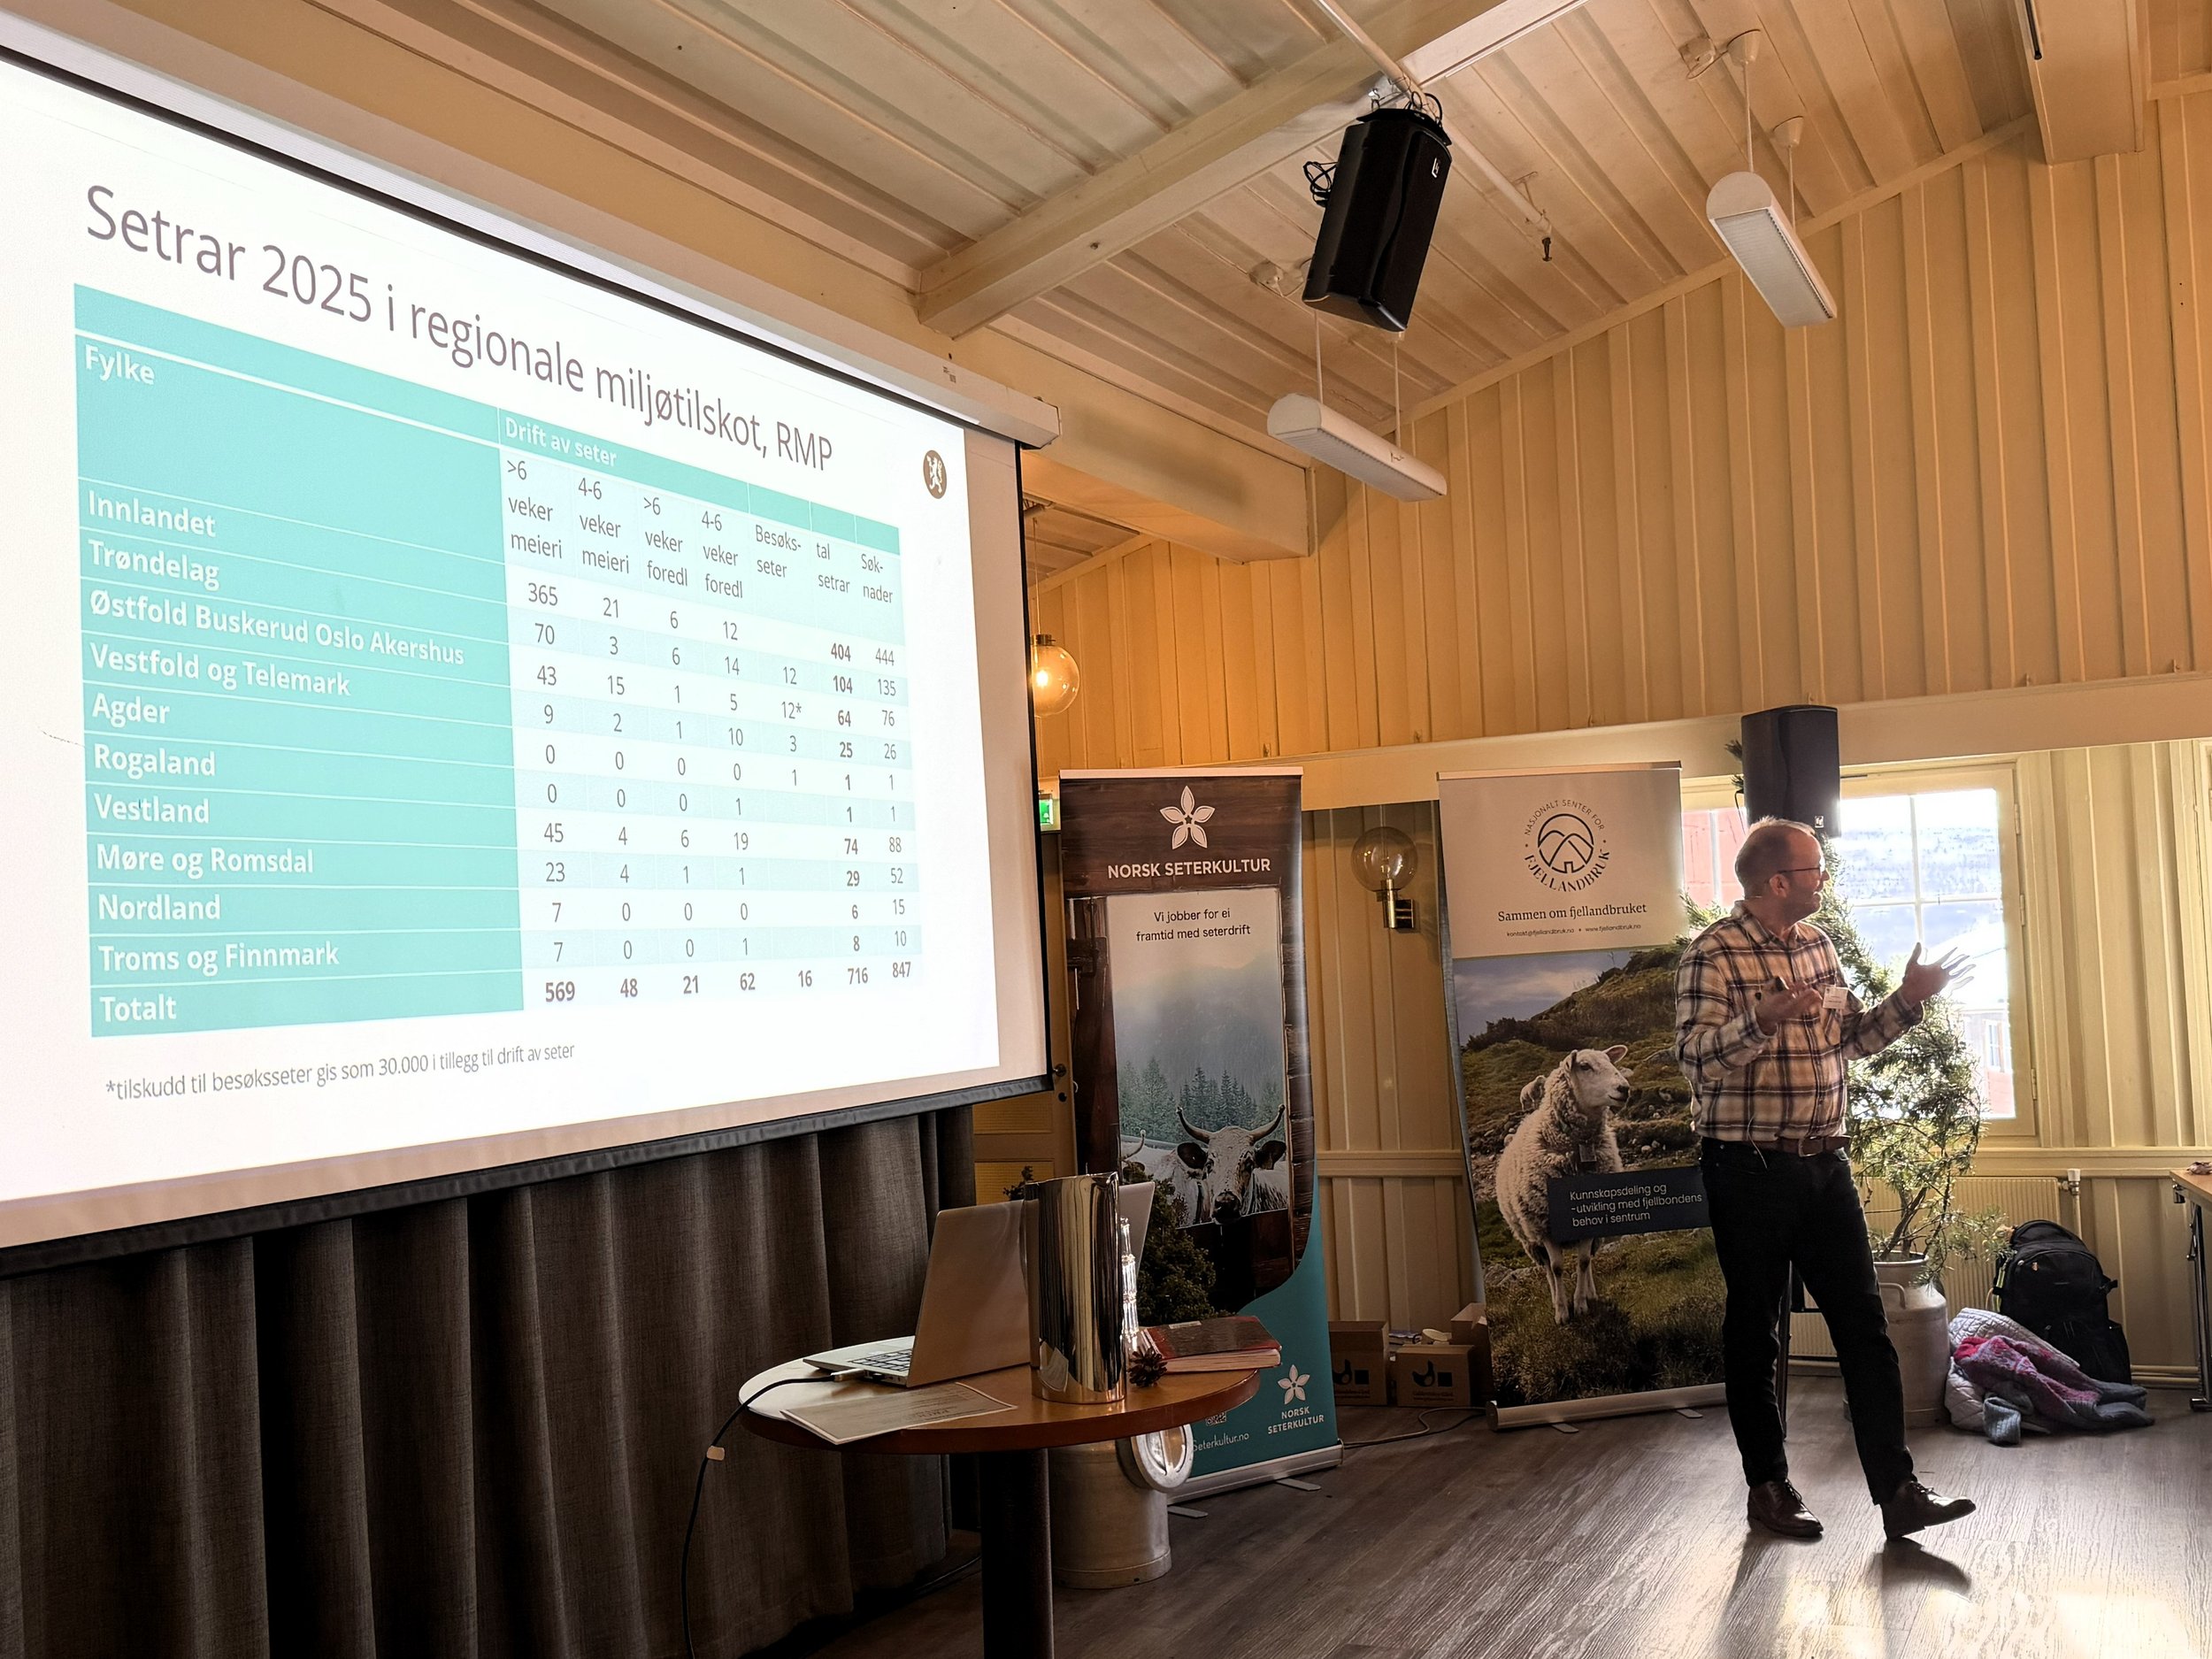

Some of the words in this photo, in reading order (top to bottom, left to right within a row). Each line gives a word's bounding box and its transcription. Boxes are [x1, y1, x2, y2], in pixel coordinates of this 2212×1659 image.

[87, 185, 246, 281] Setrar
[262, 244, 372, 323] 2025
[387, 283, 395, 332] i
[411, 303, 583, 393] regionale
[597, 365, 767, 459] miljøtilskot,
[776, 421, 833, 472] RMP
[85, 345, 156, 385] Fylke
[506, 417, 547, 448] Drift
[550, 435, 571, 455] av
[574, 441, 618, 468] seter
[506, 460, 527, 480] >6
[578, 477, 603, 501] 4-6
[88, 490, 216, 538] Innlandet
[508, 496, 554, 522] veker
[643, 496, 661, 516] >6
[579, 514, 621, 539] veker
[701, 511, 723, 532] 4-6
[511, 534, 563, 559] meieri
[644, 530, 683, 553] veker
[755, 524, 802, 551] Besøks-
[816, 542, 831, 560] tal
[88, 538, 220, 591] Trøndelag
[582, 549, 629, 574] meieri
[703, 544, 739, 566] veker
[757, 559, 787, 578] seter
[861, 553, 884, 573] Søk-
[647, 559, 688, 587] foredl
[704, 572, 743, 599] foredl
[818, 574, 850, 594] setrar
[863, 585, 894, 603] nader
[90, 588, 189, 627] Østfold
[195, 605, 310, 644] Buskerud
[315, 623, 365, 650] Oslo
[369, 630, 465, 666] Akershus
[527, 582, 558, 607] 365
[603, 596, 618, 618] 21
[670, 611, 679, 629] 6
[723, 620, 738, 641] 12
[830, 642, 851, 662] 404
[875, 648, 895, 666] 444
[90, 641, 200, 680] Vestfold
[208, 662, 236, 691] og
[242, 661, 351, 698] Telemark
[534, 622, 555, 645] 70
[609, 635, 618, 656] 3
[672, 647, 680, 665] 6
[725, 656, 740, 676] 14
[783, 666, 797, 686] 12
[833, 675, 853, 695] 104
[877, 678, 896, 696] 135
[536, 664, 557, 687] 43
[607, 675, 626, 695] 15
[674, 685, 680, 703] 1
[730, 693, 738, 711] 5
[837, 709, 851, 727] 64
[881, 709, 895, 727] 76
[91, 693, 170, 728] Agder
[543, 703, 554, 725] 9
[612, 712, 623, 733] 2
[676, 720, 682, 740] 1
[728, 727, 744, 747] 10
[789, 734, 797, 753] 3
[839, 741, 853, 758] 25
[884, 742, 897, 760] 26
[94, 744, 217, 780] Rogaland
[545, 744, 556, 764] 0
[615, 751, 625, 771] 0
[677, 757, 686, 776] 0
[733, 763, 741, 781] 0
[792, 769, 797, 787] 1
[845, 773, 851, 791] 1
[888, 773, 894, 791] 1
[94, 793, 211, 826] Vestland
[547, 783, 557, 803] 0
[617, 788, 626, 808] 0
[679, 793, 687, 812] 0
[735, 797, 741, 816] 1
[846, 806, 852, 823] 1
[890, 805, 895, 822] 1
[1525, 800, 1558, 835] NASJONALT
[1563, 800, 1591, 815] SENTER
[1591, 814, 1605, 831] FOR
[543, 822, 565, 843] 45
[618, 826, 628, 846] 4
[680, 829, 689, 849] 6
[733, 832, 749, 851] 19
[844, 838, 858, 856] 74
[888, 836, 902, 853] 88
[96, 843, 165, 873] Møre
[172, 851, 204, 879] og
[211, 848, 314, 877] Romsdal
[545, 862, 565, 882] 23
[619, 864, 630, 884] 4
[683, 865, 689, 884] 1
[739, 866, 745, 886] 1
[846, 870, 860, 887] 29
[890, 867, 903, 884] 52
[1108, 864, 1161, 879] NORSK
[1164, 858, 1271, 876] SETERKULTUR
[1525, 849, 1609, 892] FJELLANDBRUK
[98, 894, 221, 922] Nordland
[551, 902, 562, 923] 7
[622, 902, 631, 922] 0
[684, 902, 693, 921] 0
[740, 902, 749, 921] 0
[851, 904, 859, 920] 6
[893, 898, 905, 915] 15
[1154, 911, 1164, 922] Vi
[1166, 910, 1201, 924] jobber
[1203, 910, 1219, 919] for
[1222, 908, 1230, 918] ei
[1498, 910, 1547, 922] Sammen
[1549, 910, 1567, 918] om
[1570, 903, 1647, 919] fjellandbruket
[553, 941, 564, 963] 7
[623, 940, 633, 960] 0
[685, 939, 695, 957] 0
[742, 937, 749, 956] 1
[853, 935, 860, 952] 8
[895, 930, 907, 947] 10
[1136, 930, 1173, 941] framtid
[1177, 928, 1200, 940] med
[1203, 925, 1251, 937] seterdrift
[98, 943, 179, 973] Troms
[188, 948, 219, 976] og
[225, 941, 340, 970] Finnmark
[545, 980, 575, 1002] 569
[619, 978, 639, 998] 48
[682, 974, 699, 995] 21
[740, 972, 756, 991] 62
[798, 970, 812, 988] 16
[847, 966, 869, 985] 716
[892, 961, 911, 979] 847
[100, 993, 177, 1023] Totalt
[191, 1072, 206, 1094] til
[212, 1068, 313, 1092] besøksseter
[317, 1063, 337, 1087] gis
[341, 1063, 374, 1080] som
[379, 1055, 429, 1076] 30.000
[432, 1055, 436, 1071] i
[439, 1051, 480, 1073] tillegg
[481, 1048, 494, 1067] til
[497, 1045, 525, 1065] drift
[527, 1048, 541, 1062] av
[544, 1045, 575, 1061] seter
[1571, 1185, 1650, 1201] Kunnskapsdeling
[1654, 1184, 1666, 1194] og
[1571, 1201, 1616, 1213] -utvikling
[1618, 1200, 1640, 1210] med
[1643, 1194, 1702, 1209] fjellbondens
[1572, 1216, 1603, 1226] behov
[1611, 1211, 1650, 1224] sentrum
[1268, 1415, 1325, 1434] SETERKULTUR
[1281, 1406, 1310, 1419] NORSK
